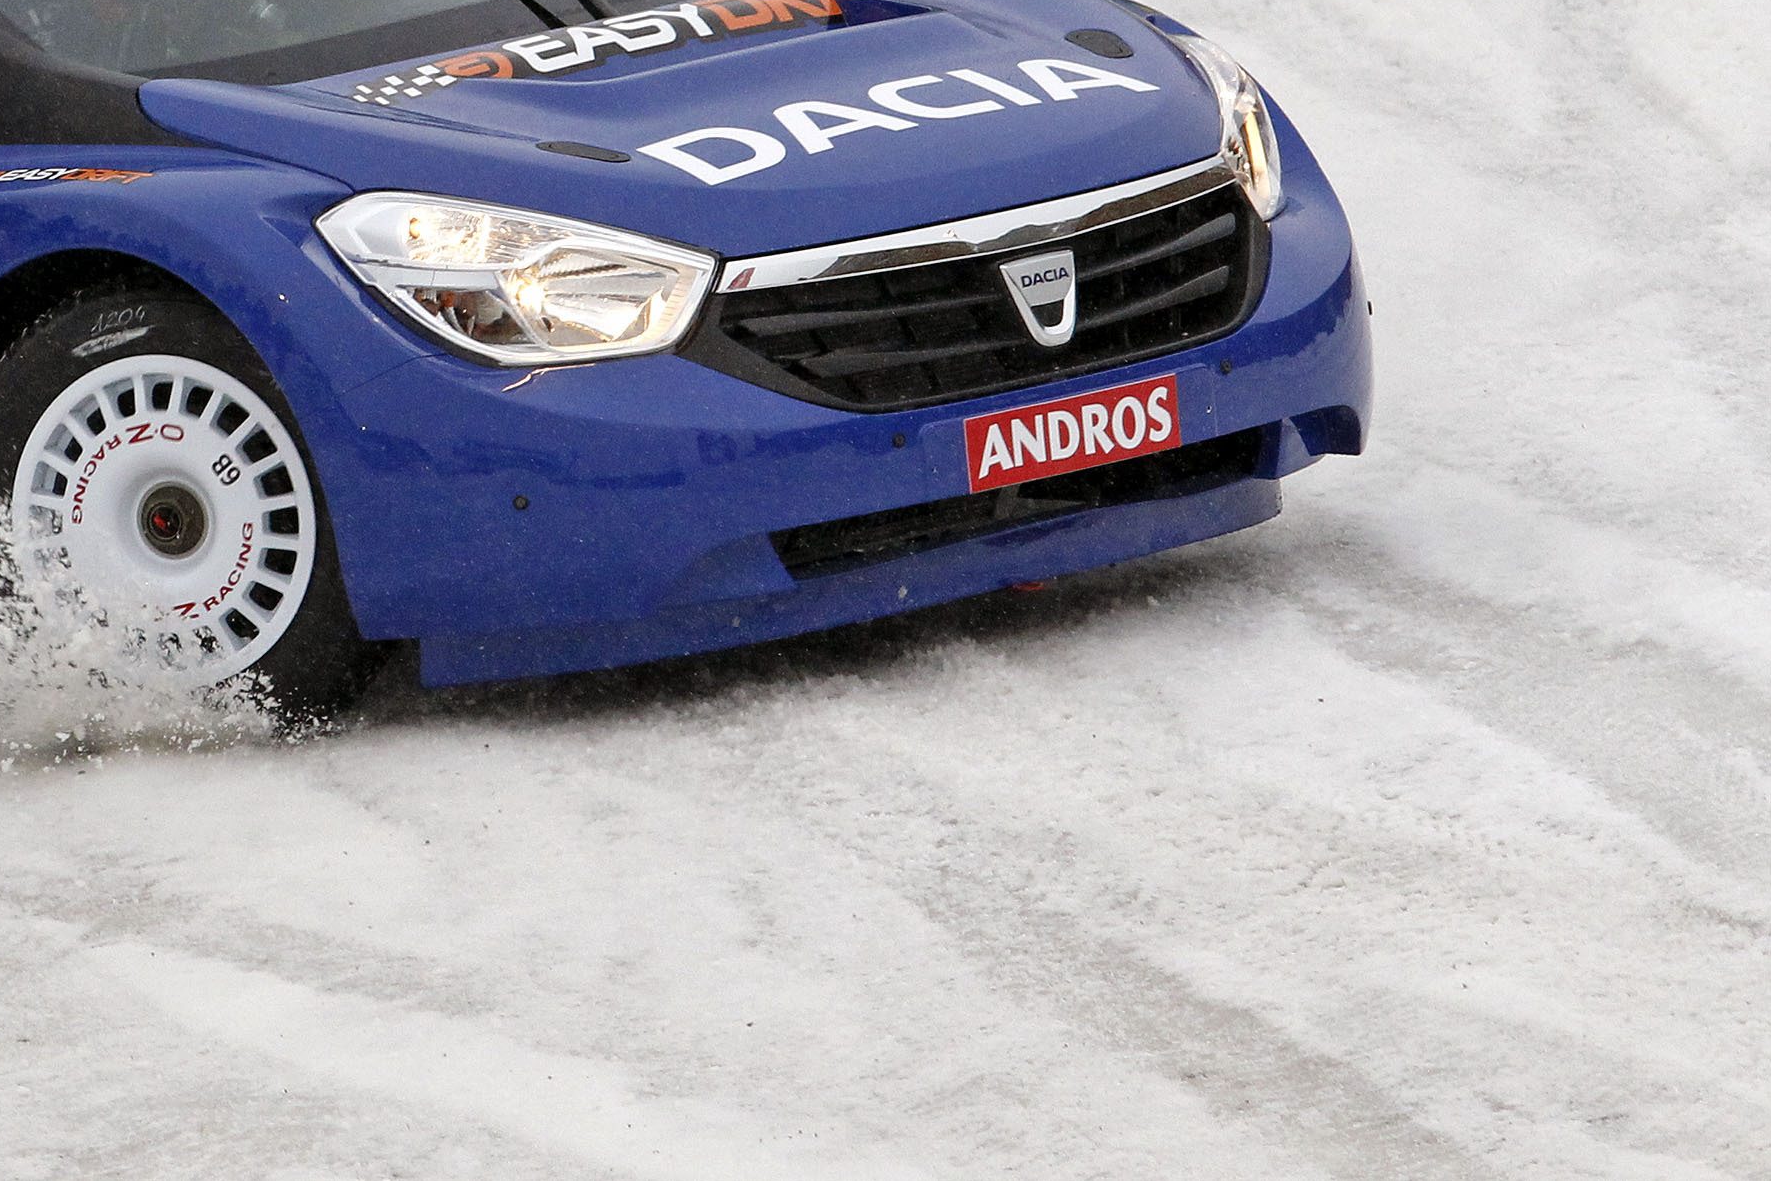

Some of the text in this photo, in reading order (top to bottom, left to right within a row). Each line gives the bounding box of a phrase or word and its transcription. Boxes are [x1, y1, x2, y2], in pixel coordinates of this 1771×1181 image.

[635, 59, 1161, 186] DACIA
[1021, 267, 1069, 288] DACIA
[978, 386, 1172, 480] ANDROS
[72, 435, 122, 524] RACING
[203, 522, 254, 611] RACING
